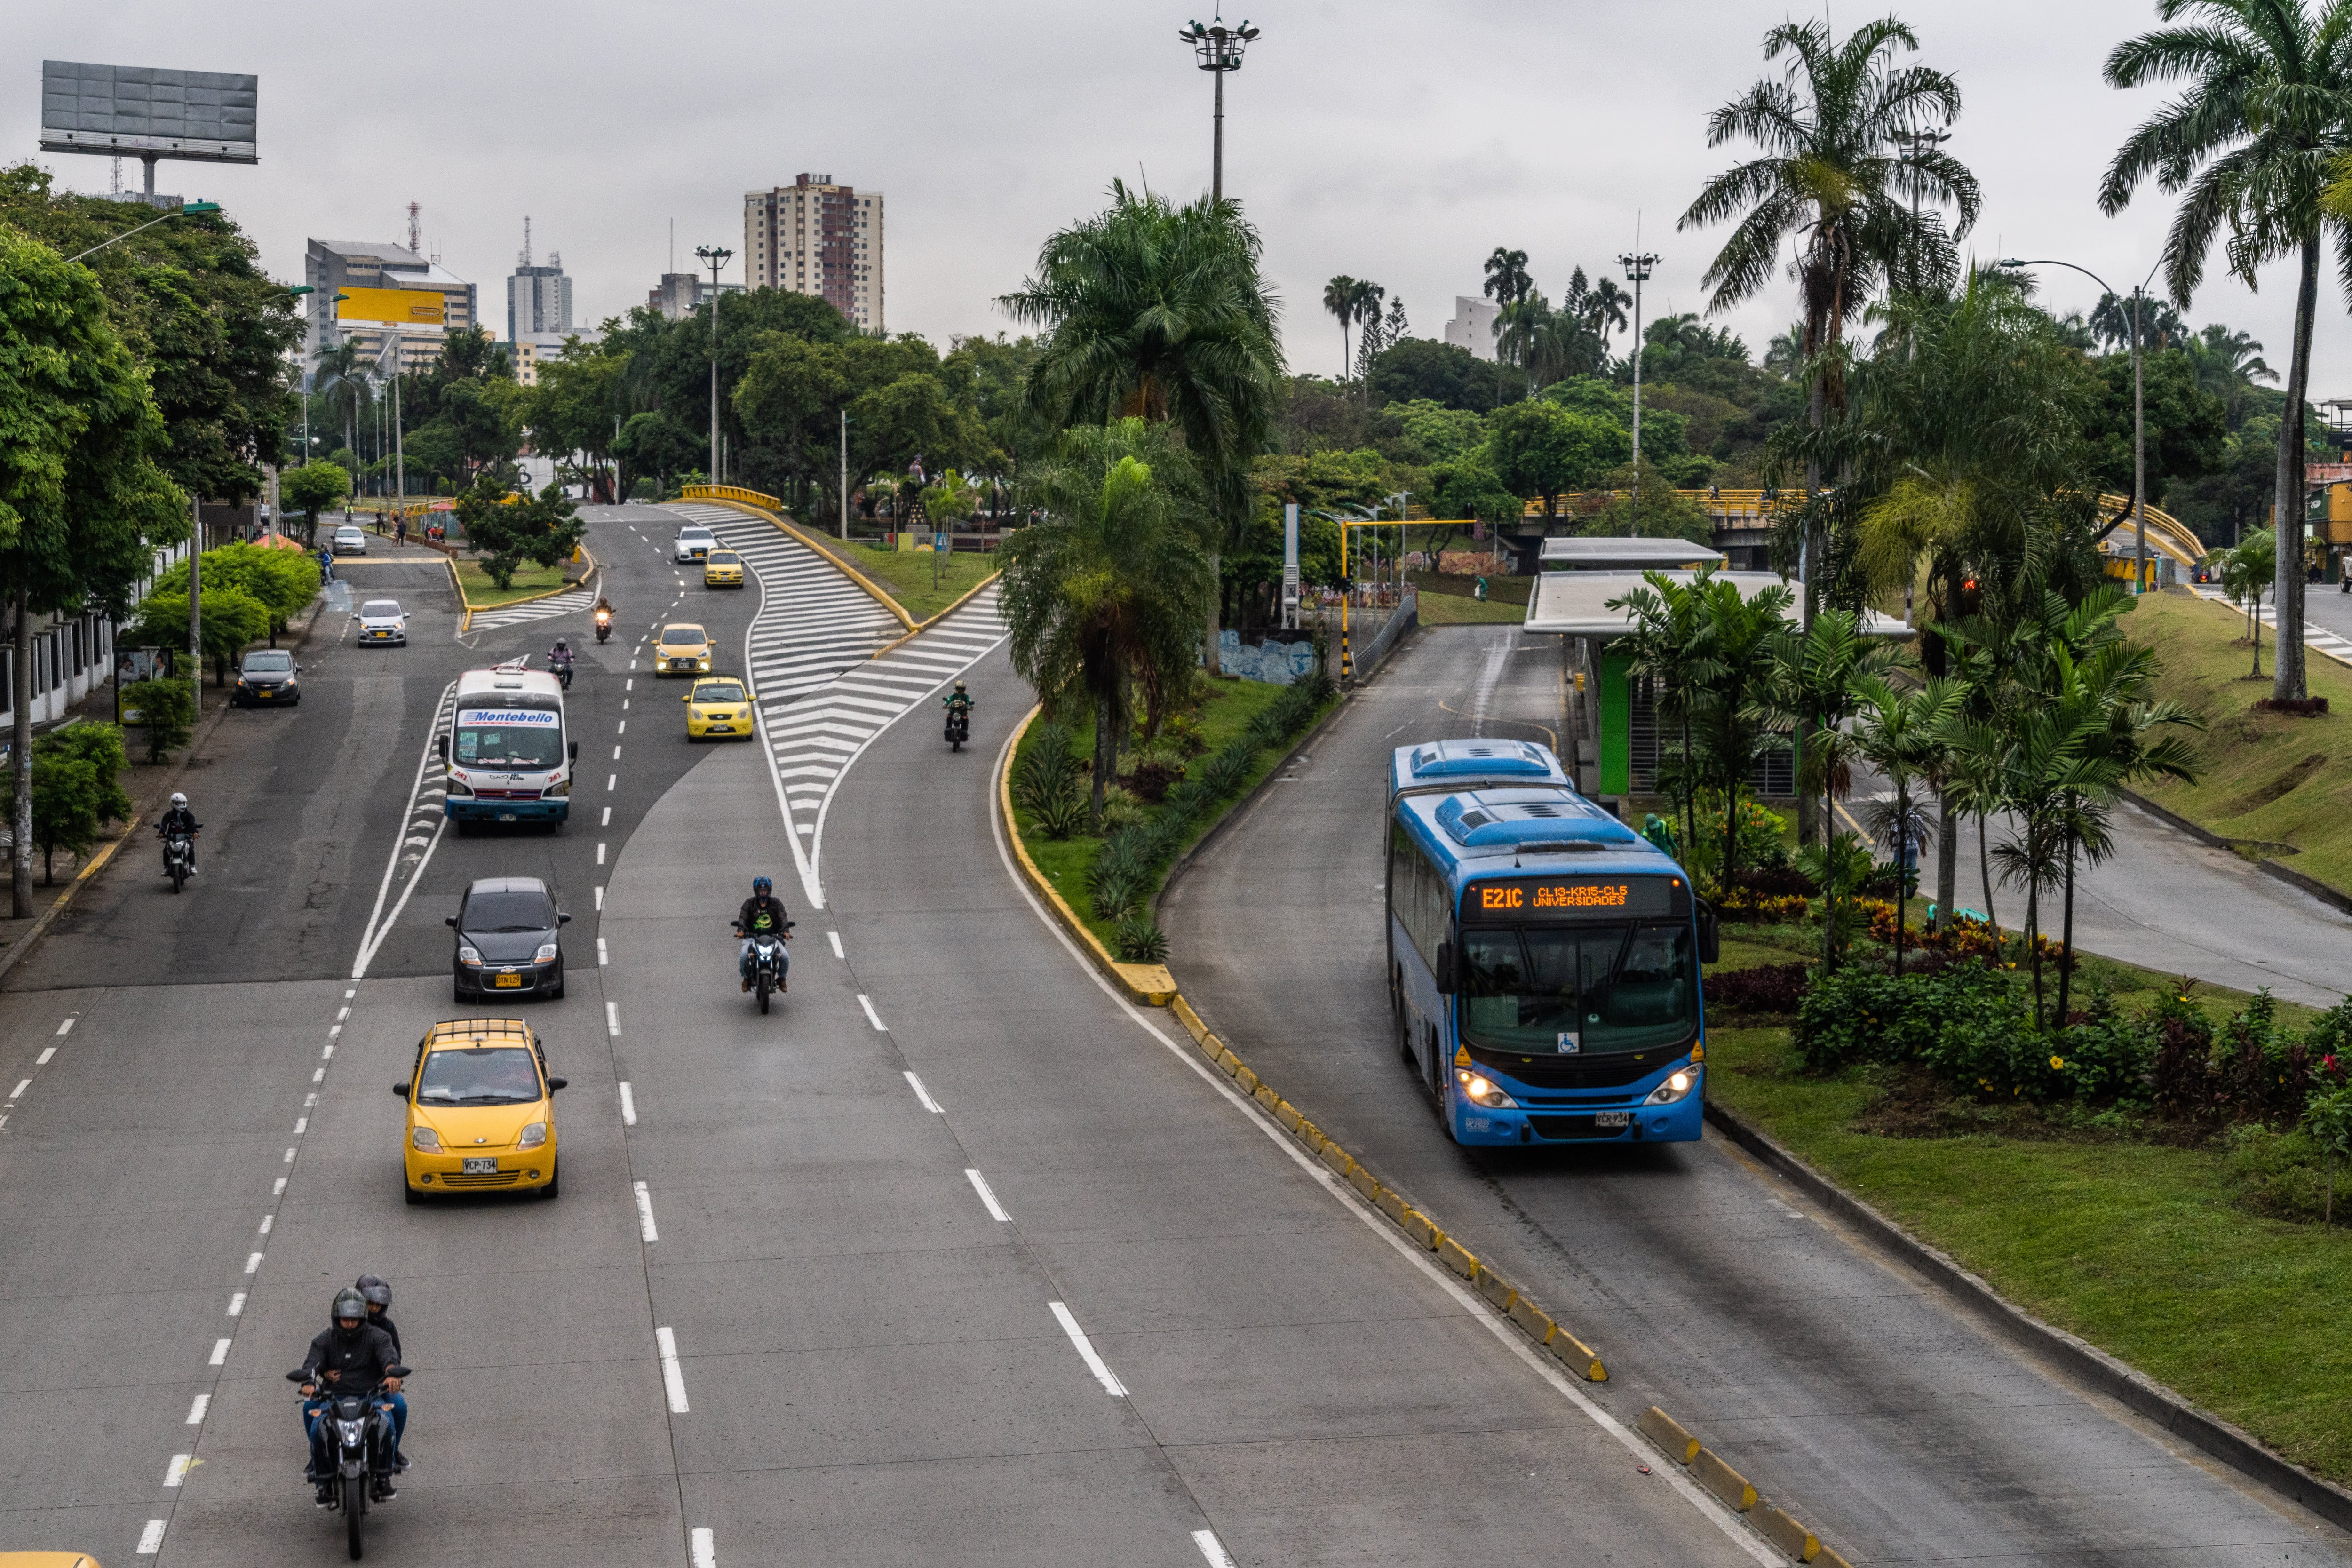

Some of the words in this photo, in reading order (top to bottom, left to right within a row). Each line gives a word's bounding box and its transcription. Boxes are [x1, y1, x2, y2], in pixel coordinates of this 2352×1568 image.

[475, 712, 553, 723] Montebello
[454, 771, 468, 780] 241
[548, 772, 562, 783] 241
[1538, 885, 1628, 897] CL13-KR15-CL5
[1483, 888, 1523, 908] E21C
[1533, 895, 1625, 907] UNIVERSIDADES
